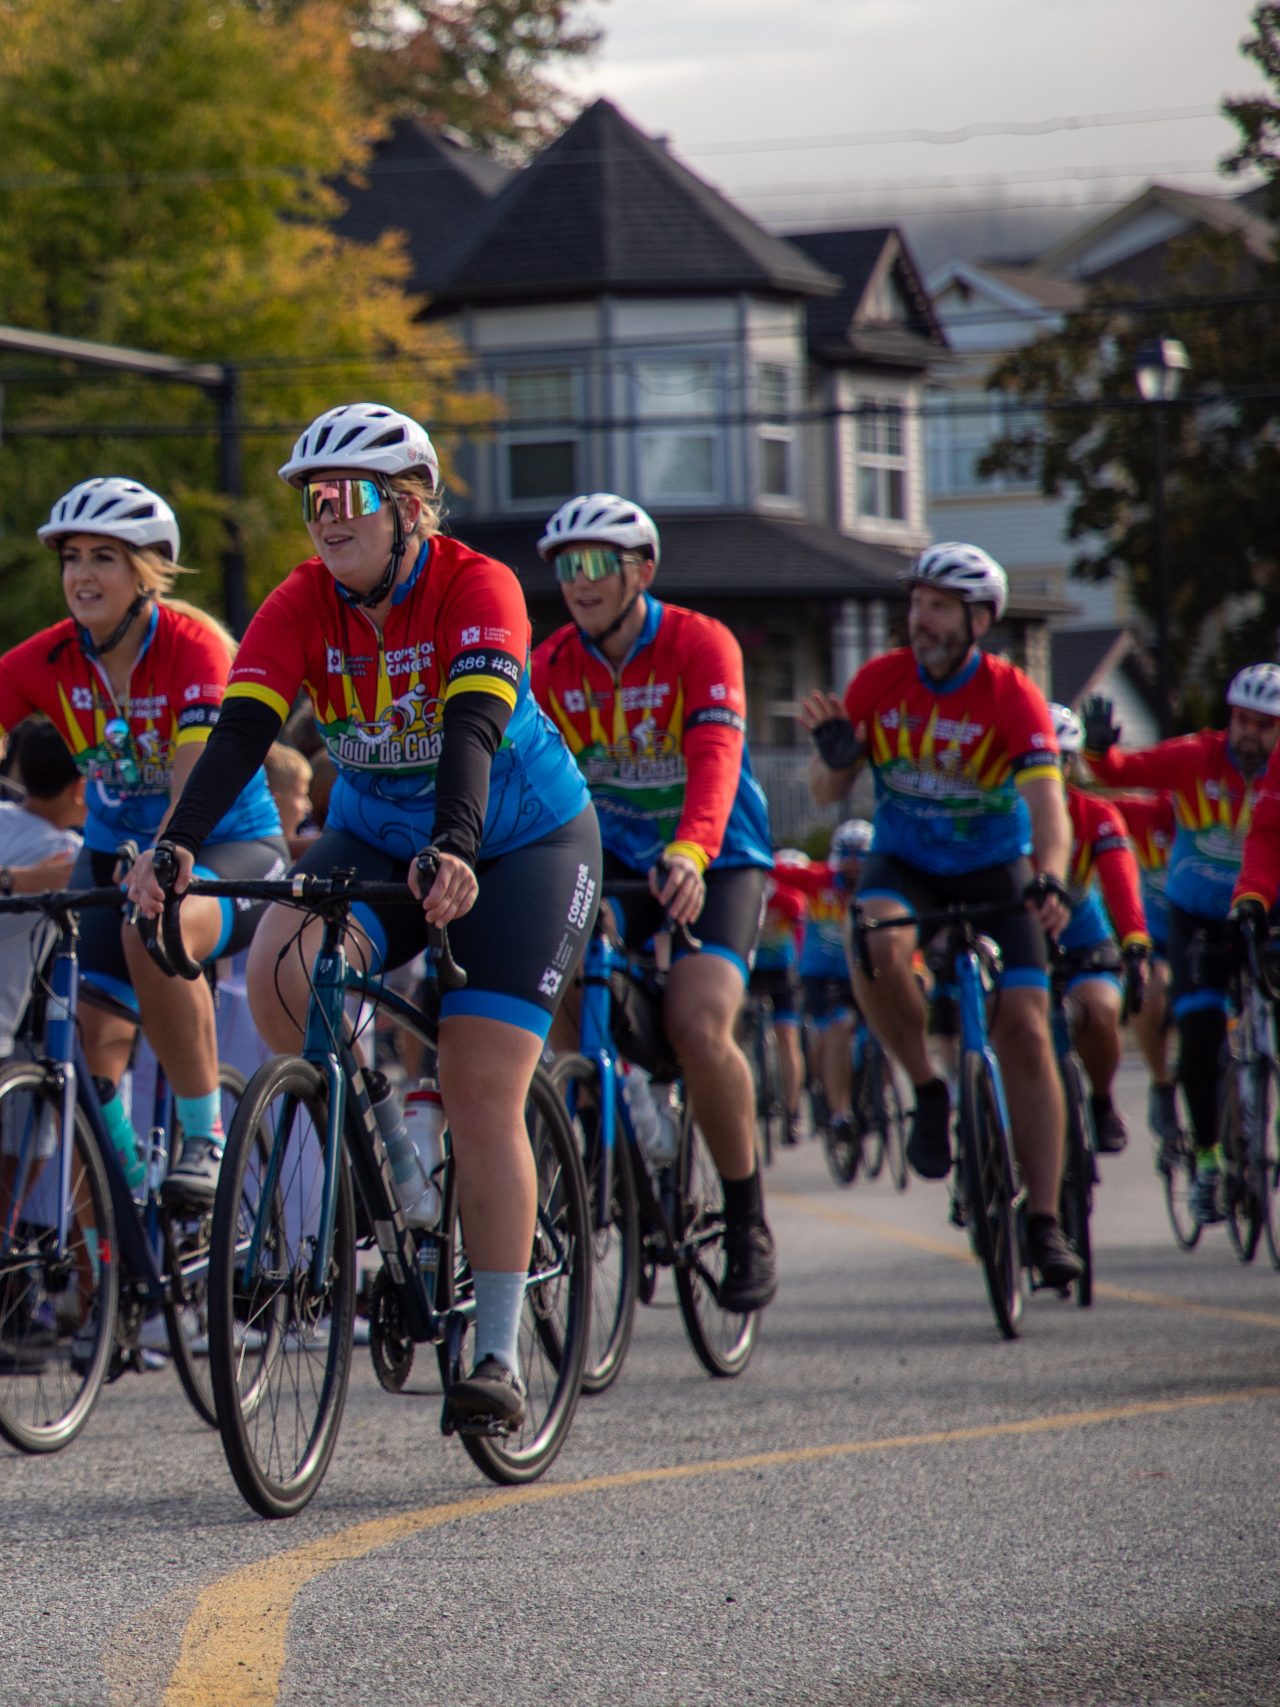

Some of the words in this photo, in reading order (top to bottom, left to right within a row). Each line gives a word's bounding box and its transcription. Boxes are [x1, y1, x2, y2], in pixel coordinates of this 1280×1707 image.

[386, 656, 432, 676] CANCER
[337, 732, 376, 763] Tour
[380, 740, 401, 763] de
[575, 863, 590, 890] FOR
[567, 888, 585, 924] COPS
[577, 878, 596, 929] CANCER
